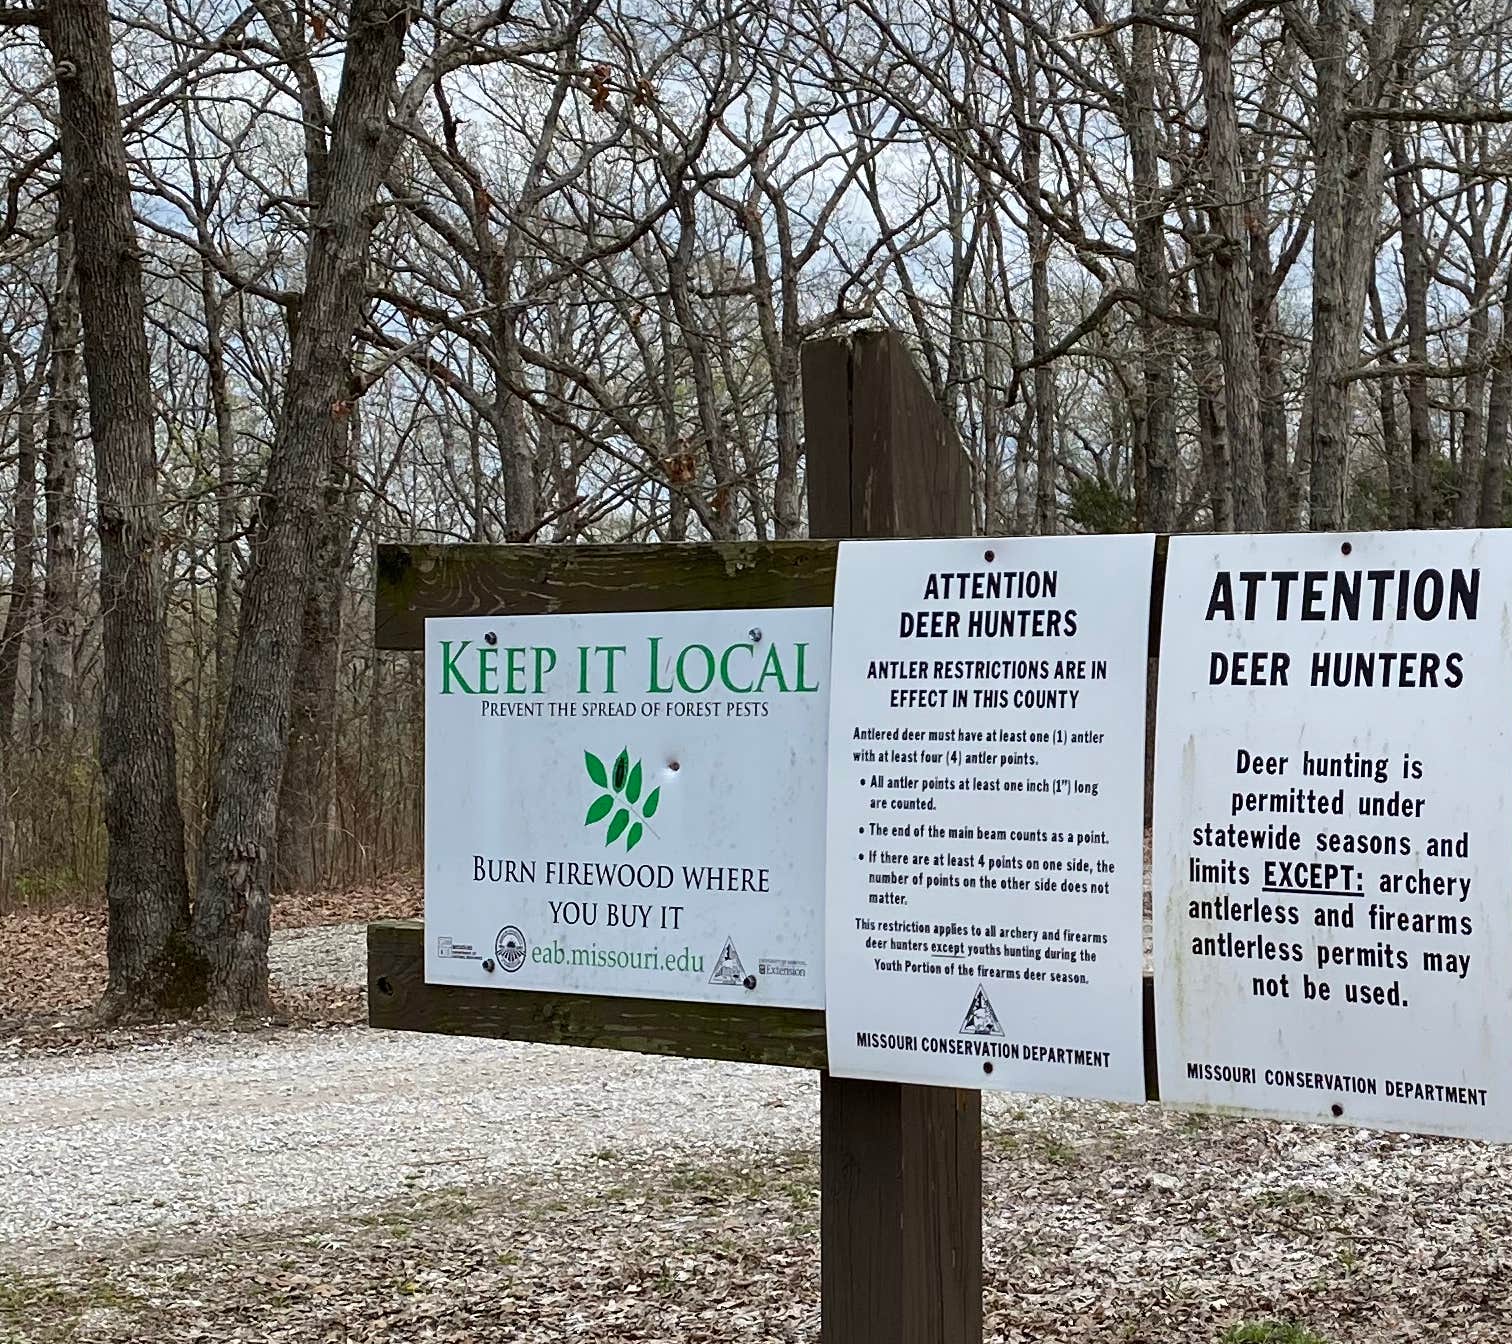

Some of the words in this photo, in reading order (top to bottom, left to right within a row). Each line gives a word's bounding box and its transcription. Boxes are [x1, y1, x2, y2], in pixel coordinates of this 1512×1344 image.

[923, 570, 1058, 600] ATTENTION
[1204, 568, 1480, 622] ATTENTION
[900, 611, 960, 638] DEER
[968, 609, 1078, 638] HUNTERS
[439, 641, 556, 694] KEEP
[577, 646, 626, 694] IT
[646, 637, 819, 694] LOCAL
[866, 661, 928, 680] ANTLER
[933, 660, 1049, 680] RESTRICTIONS
[1054, 660, 1086, 680] ARE
[1091, 660, 1107, 680] IN
[1209, 652, 1290, 686] DEER
[1310, 652, 1464, 688] HUNTERS
[482, 700, 544, 716] PREVENT
[547, 702, 577, 717] THE
[582, 702, 636, 717] SPREAD
[641, 702, 660, 717] OF
[666, 702, 722, 717] FOREST
[726, 702, 768, 717] PESTS
[890, 689, 948, 708] EFFECT
[952, 690, 968, 708] IN
[973, 689, 1008, 708] THIS
[1013, 689, 1080, 709] COUNTY
[853, 726, 900, 740] Antlered
[902, 728, 926, 741] deer
[928, 729, 956, 742] must
[958, 728, 983, 742] have
[986, 729, 997, 742] at
[999, 729, 1027, 742] least
[1030, 732, 1050, 742] one
[1052, 730, 1067, 746] (1)
[1071, 730, 1104, 744] antler
[1236, 749, 1288, 775] Deer
[1303, 750, 1389, 784] hunting
[1403, 753, 1422, 780] is
[1232, 787, 1344, 816] permitted
[1358, 790, 1426, 818] under
[1192, 822, 1300, 851] statewide
[1316, 832, 1411, 856] seasons
[1426, 832, 1468, 858] and
[472, 855, 536, 883] BURN
[545, 862, 674, 888] FIREWOOD
[682, 866, 770, 892] WHERE
[1189, 857, 1250, 885] limits
[1262, 860, 1365, 898] EXCEPT:
[1380, 868, 1471, 902] archery
[548, 900, 598, 926] YOU
[606, 903, 653, 928] BUY
[660, 906, 684, 930] IT
[1188, 895, 1299, 925] antlerless
[1314, 902, 1354, 928] and
[1368, 904, 1472, 936] firearms
[532, 940, 704, 973] eab.missouri.edu
[1192, 932, 1303, 962] antlerless
[1317, 942, 1408, 970] permits
[1423, 952, 1470, 979] may
[1252, 974, 1290, 998] not
[1303, 974, 1330, 1001] be
[1345, 980, 1408, 1007] used.
[856, 1032, 918, 1051] MISSOURI
[921, 1037, 1020, 1059] CONSERVATION
[1022, 1045, 1110, 1068] DEPARTMENT
[1187, 1062, 1256, 1084] MISSOURI
[1264, 1069, 1376, 1095] CONSERVATION
[1385, 1080, 1488, 1106] DEPARTMENT
